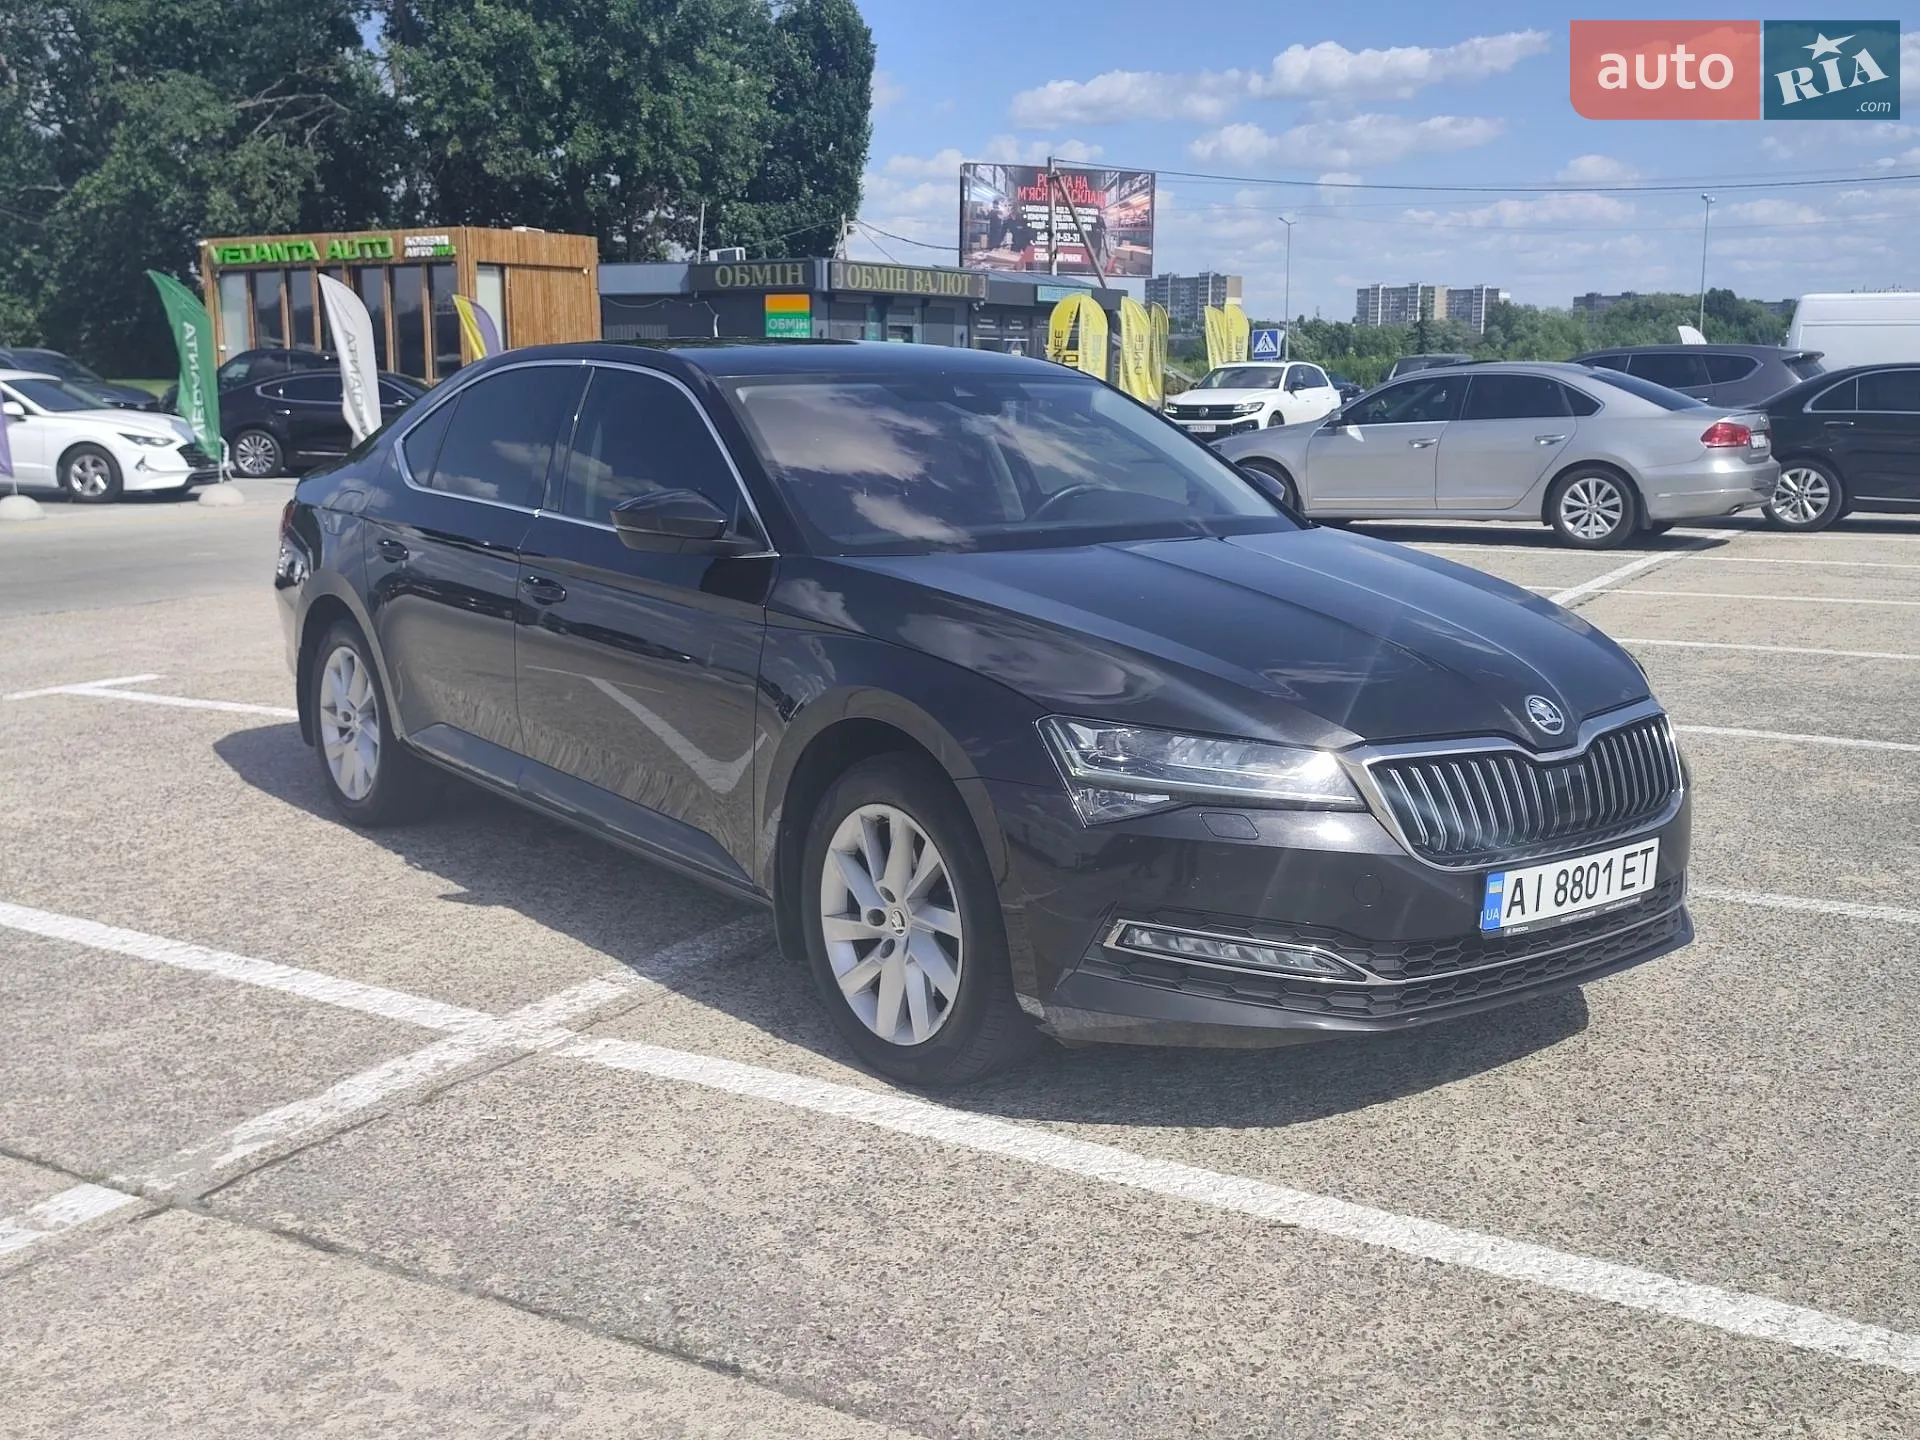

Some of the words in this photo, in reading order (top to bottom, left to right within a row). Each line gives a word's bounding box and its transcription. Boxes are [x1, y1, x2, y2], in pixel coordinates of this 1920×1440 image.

[1037, 173, 1074, 189] РОТА
[1075, 175, 1089, 189] НА
[1017, 186, 1069, 202] М'ЯСНМ
[210, 239, 321, 265] VEDANTA
[325, 236, 394, 260] AUTO
[714, 263, 806, 288] ОБМІН
[846, 265, 909, 292] ОБМІН
[912, 270, 973, 297] ВАЛЮТ
[768, 318, 809, 330] ОБМІН
[1506, 873, 1543, 918] AI
[1554, 858, 1614, 907] 8801
[1620, 846, 1655, 891] ET
[1486, 908, 1500, 921] UA
